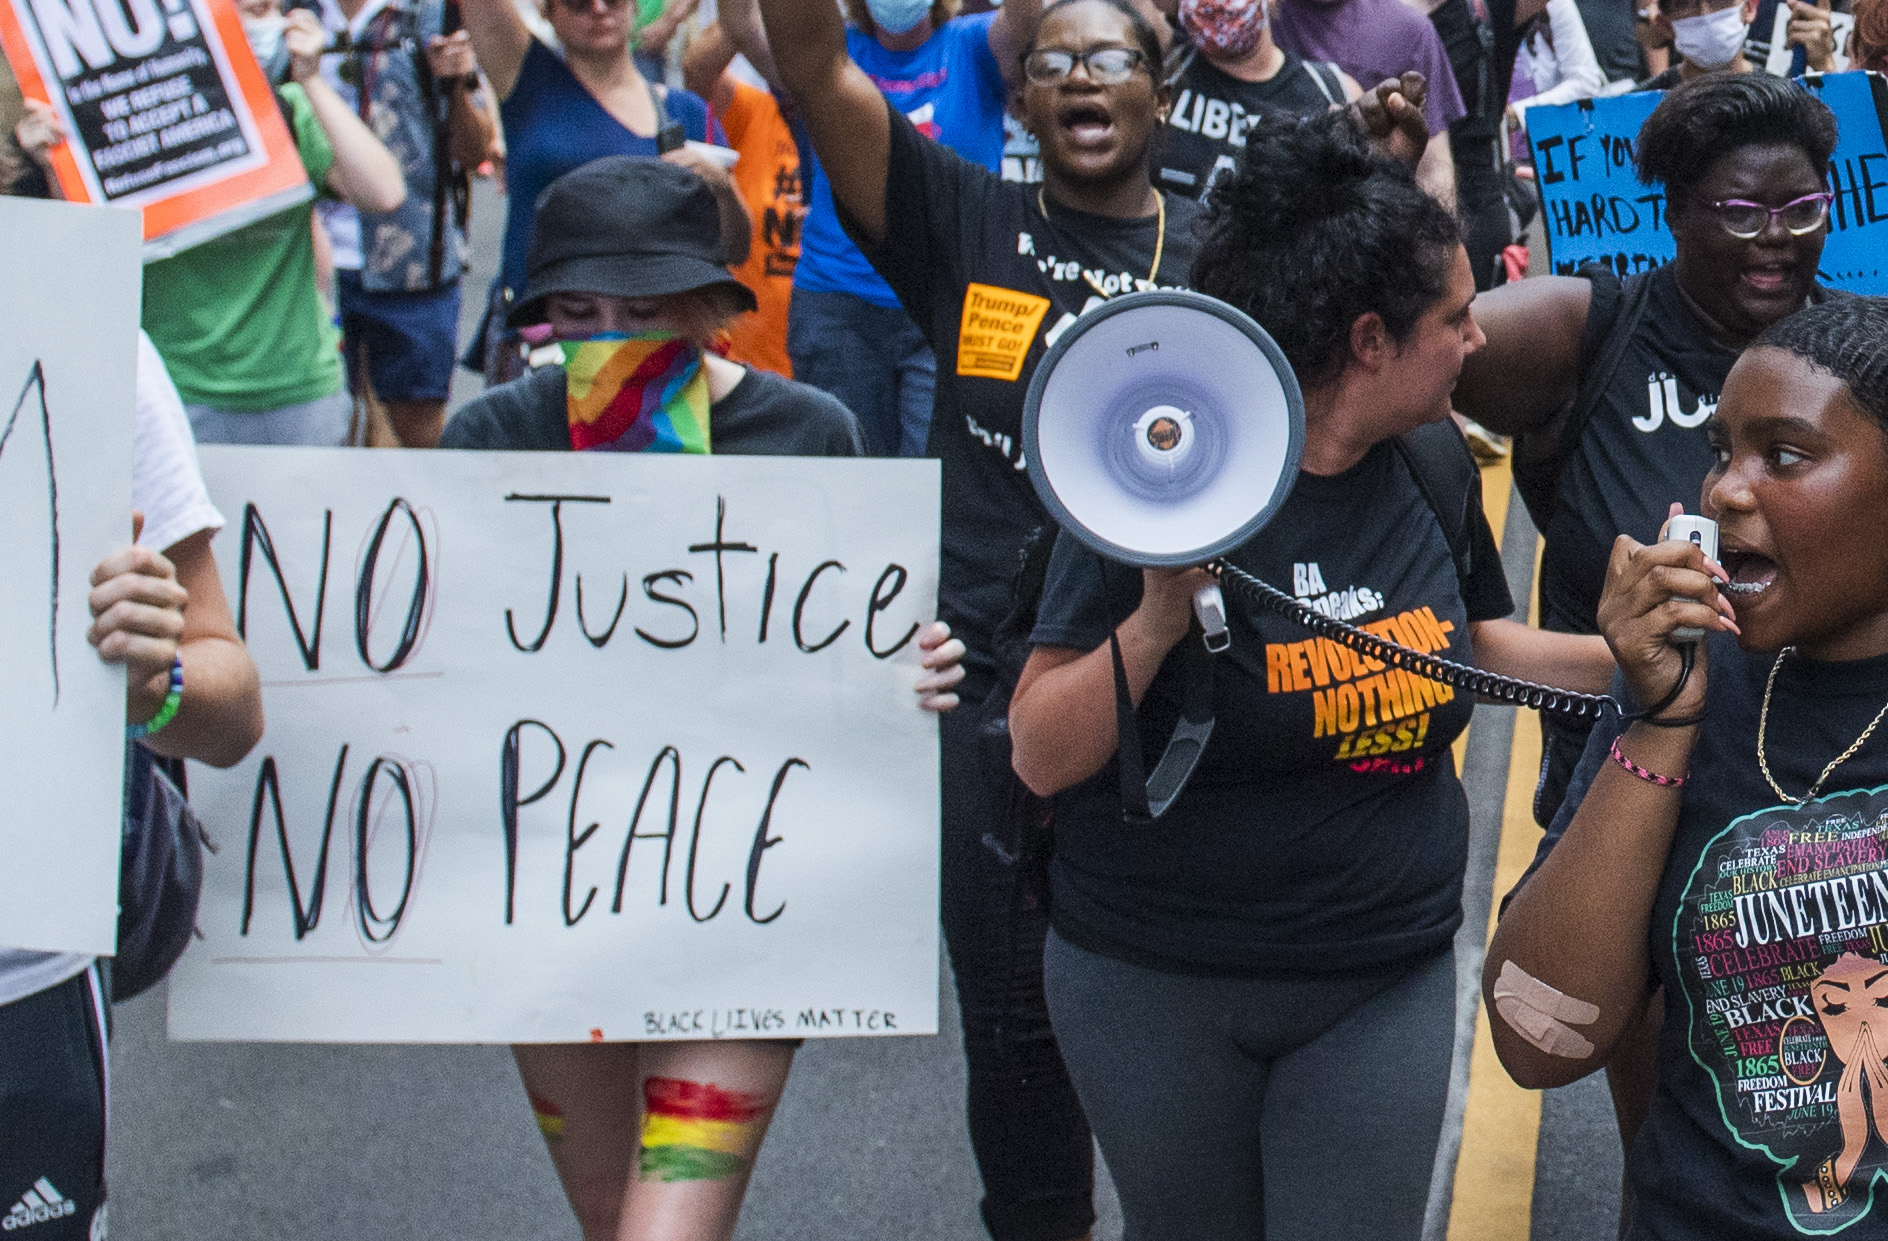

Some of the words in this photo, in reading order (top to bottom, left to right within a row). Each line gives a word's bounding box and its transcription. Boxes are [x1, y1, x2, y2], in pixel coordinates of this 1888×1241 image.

[1537, 133, 1588, 184] IF
[1551, 193, 1639, 238] HARD
[970, 292, 1040, 316] Trump/
[968, 312, 1024, 334] Pence
[238, 498, 430, 673] NO
[504, 493, 920, 661] Justice
[1293, 562, 1327, 598] BA
[1312, 667, 1455, 740] NOTHING
[1333, 712, 1431, 760] LESS!
[241, 744, 420, 942] NO
[501, 719, 810, 928] PEACE
[1789, 831, 1840, 845] FREE
[1816, 820, 1860, 833] TEXAS
[1745, 844, 1786, 858] TEXAS
[1787, 835, 1879, 859] EMANCIPATION
[1719, 854, 1777, 871] CELEBRATE
[1777, 857, 1810, 879] END
[1814, 842, 1888, 871] SLAVERY
[1739, 864, 1778, 875] HISTORY
[1709, 889, 1733, 902] TEXAS
[1732, 870, 1778, 896] BLACK
[1780, 870, 1823, 887] CELEBRATE
[1701, 899, 1734, 913] FREEDOM
[1703, 911, 1736, 931] 1865
[1695, 930, 1735, 953] 1865
[1818, 927, 1868, 945] FREEDOM
[1821, 944, 1844, 955] FREE
[1695, 955, 1713, 980] TEXAS
[1709, 936, 1821, 977] CELEBRATE
[1732, 976, 1745, 993] 19
[1745, 968, 1780, 989] 1865
[1780, 962, 1822, 981] BLACK
[1706, 998, 1730, 1014] END
[1730, 984, 1787, 1009] SLAVERY
[1724, 994, 1815, 1029] BLACK
[643, 1010, 703, 1035] BLACK
[796, 1007, 898, 1030] MATTER
[1733, 1022, 1781, 1041] TEXAS
[1740, 1039, 1774, 1057] FREE
[1736, 1055, 1780, 1078] 1865
[1784, 1048, 1822, 1066] BLACK
[1737, 1074, 1788, 1092] FREEDOM
[1752, 1081, 1837, 1113] FESTIVAL
[1788, 1105, 1817, 1120] JUNE
[1820, 1103, 1834, 1117] 19
[2, 1200, 76, 1230] adidas
